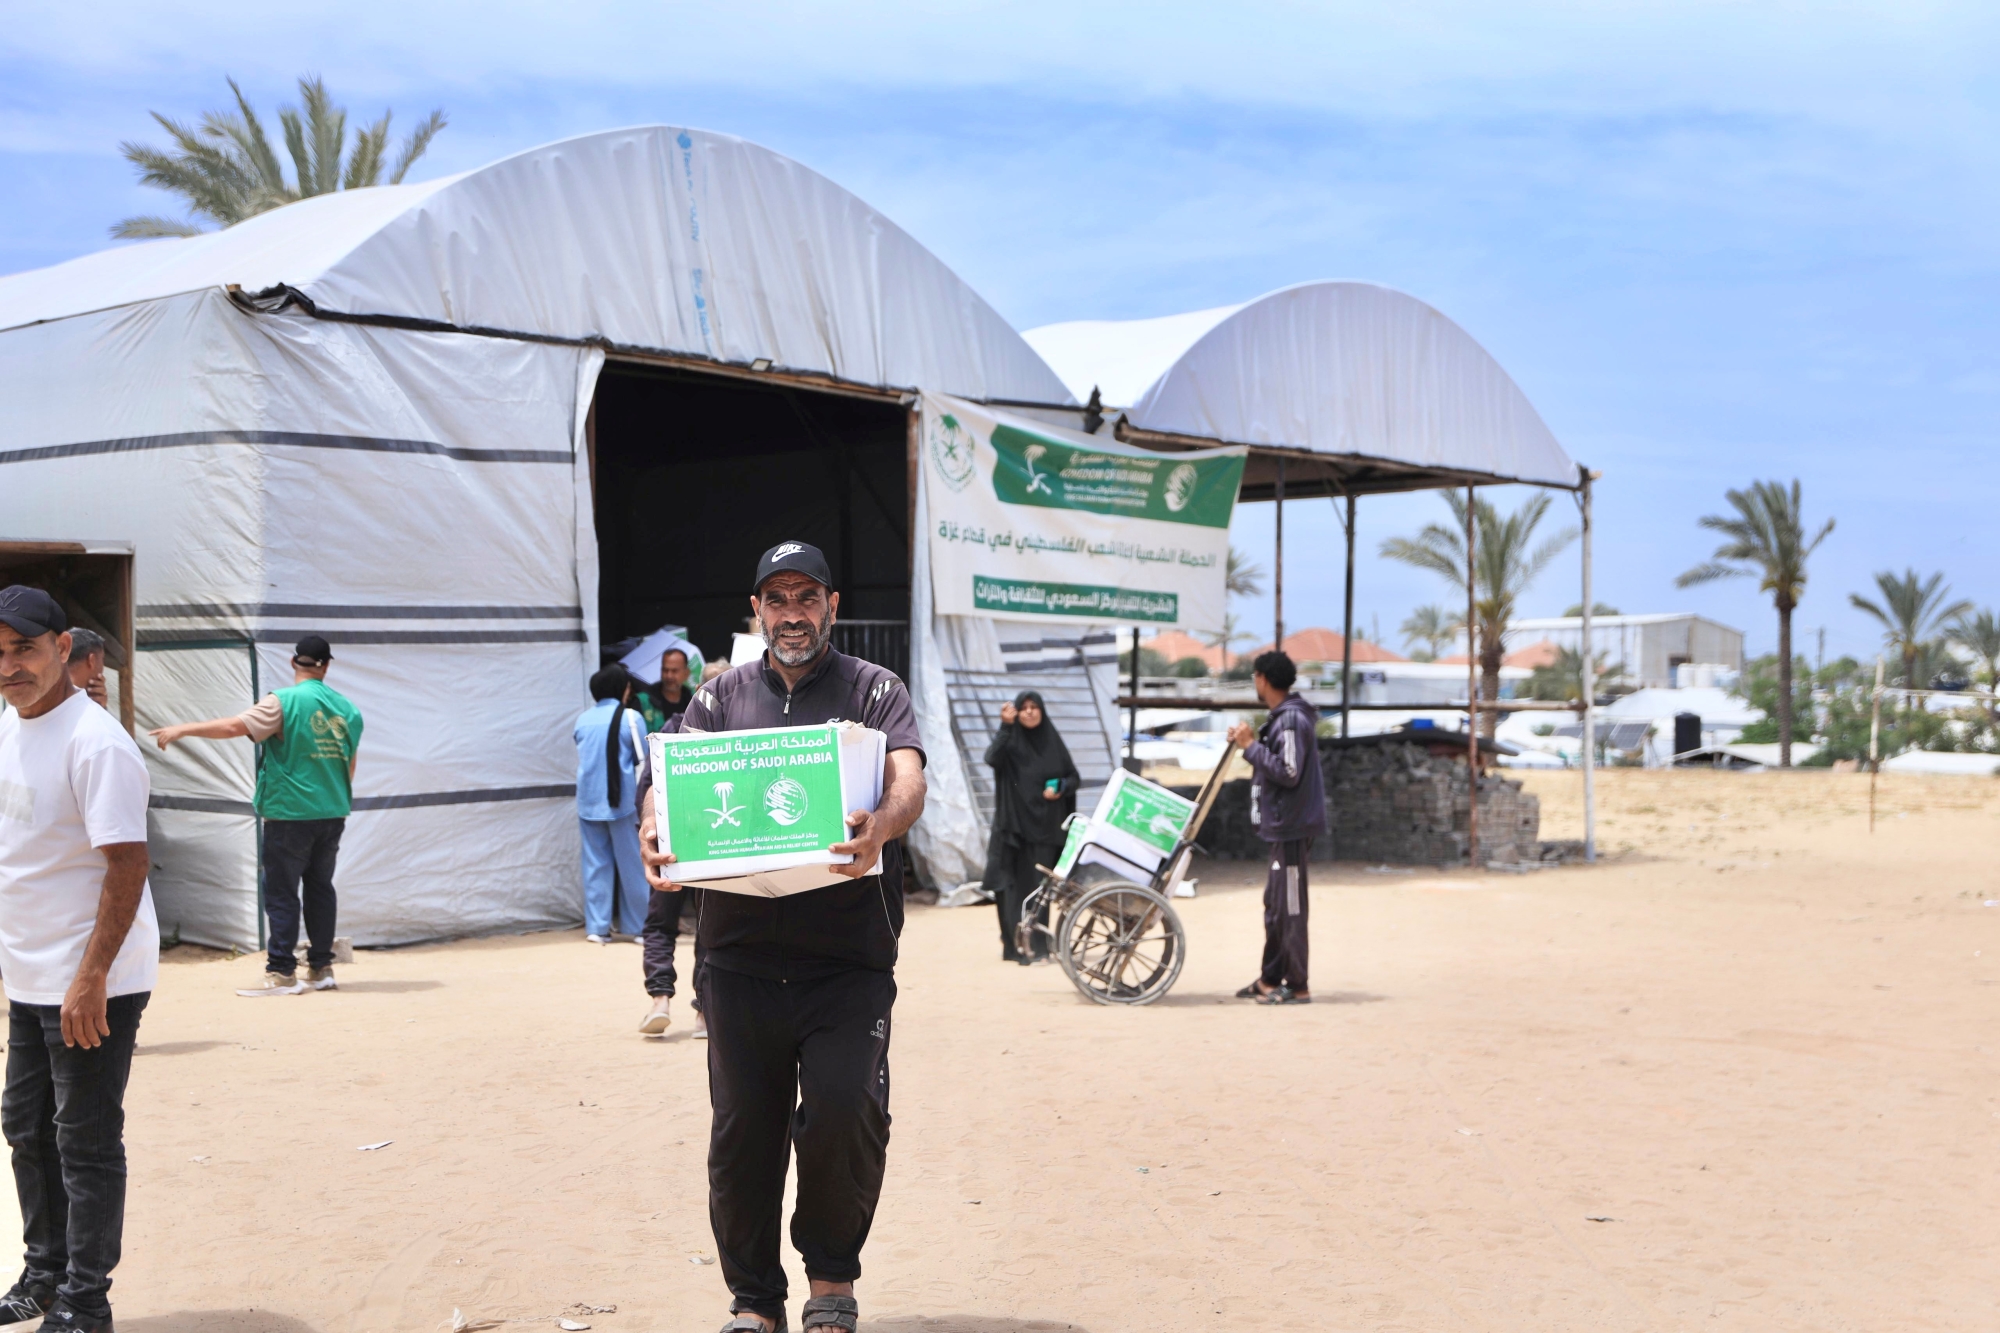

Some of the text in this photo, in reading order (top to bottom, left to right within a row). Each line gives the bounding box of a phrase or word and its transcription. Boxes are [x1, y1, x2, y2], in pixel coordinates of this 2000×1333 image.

[988, 530, 1012, 553] في
[1046, 591, 1100, 611] السعودي
[670, 732, 832, 761] المملكة العربية السعودية
[671, 751, 833, 776] KINGDOM OF SAUDI ARABIA
